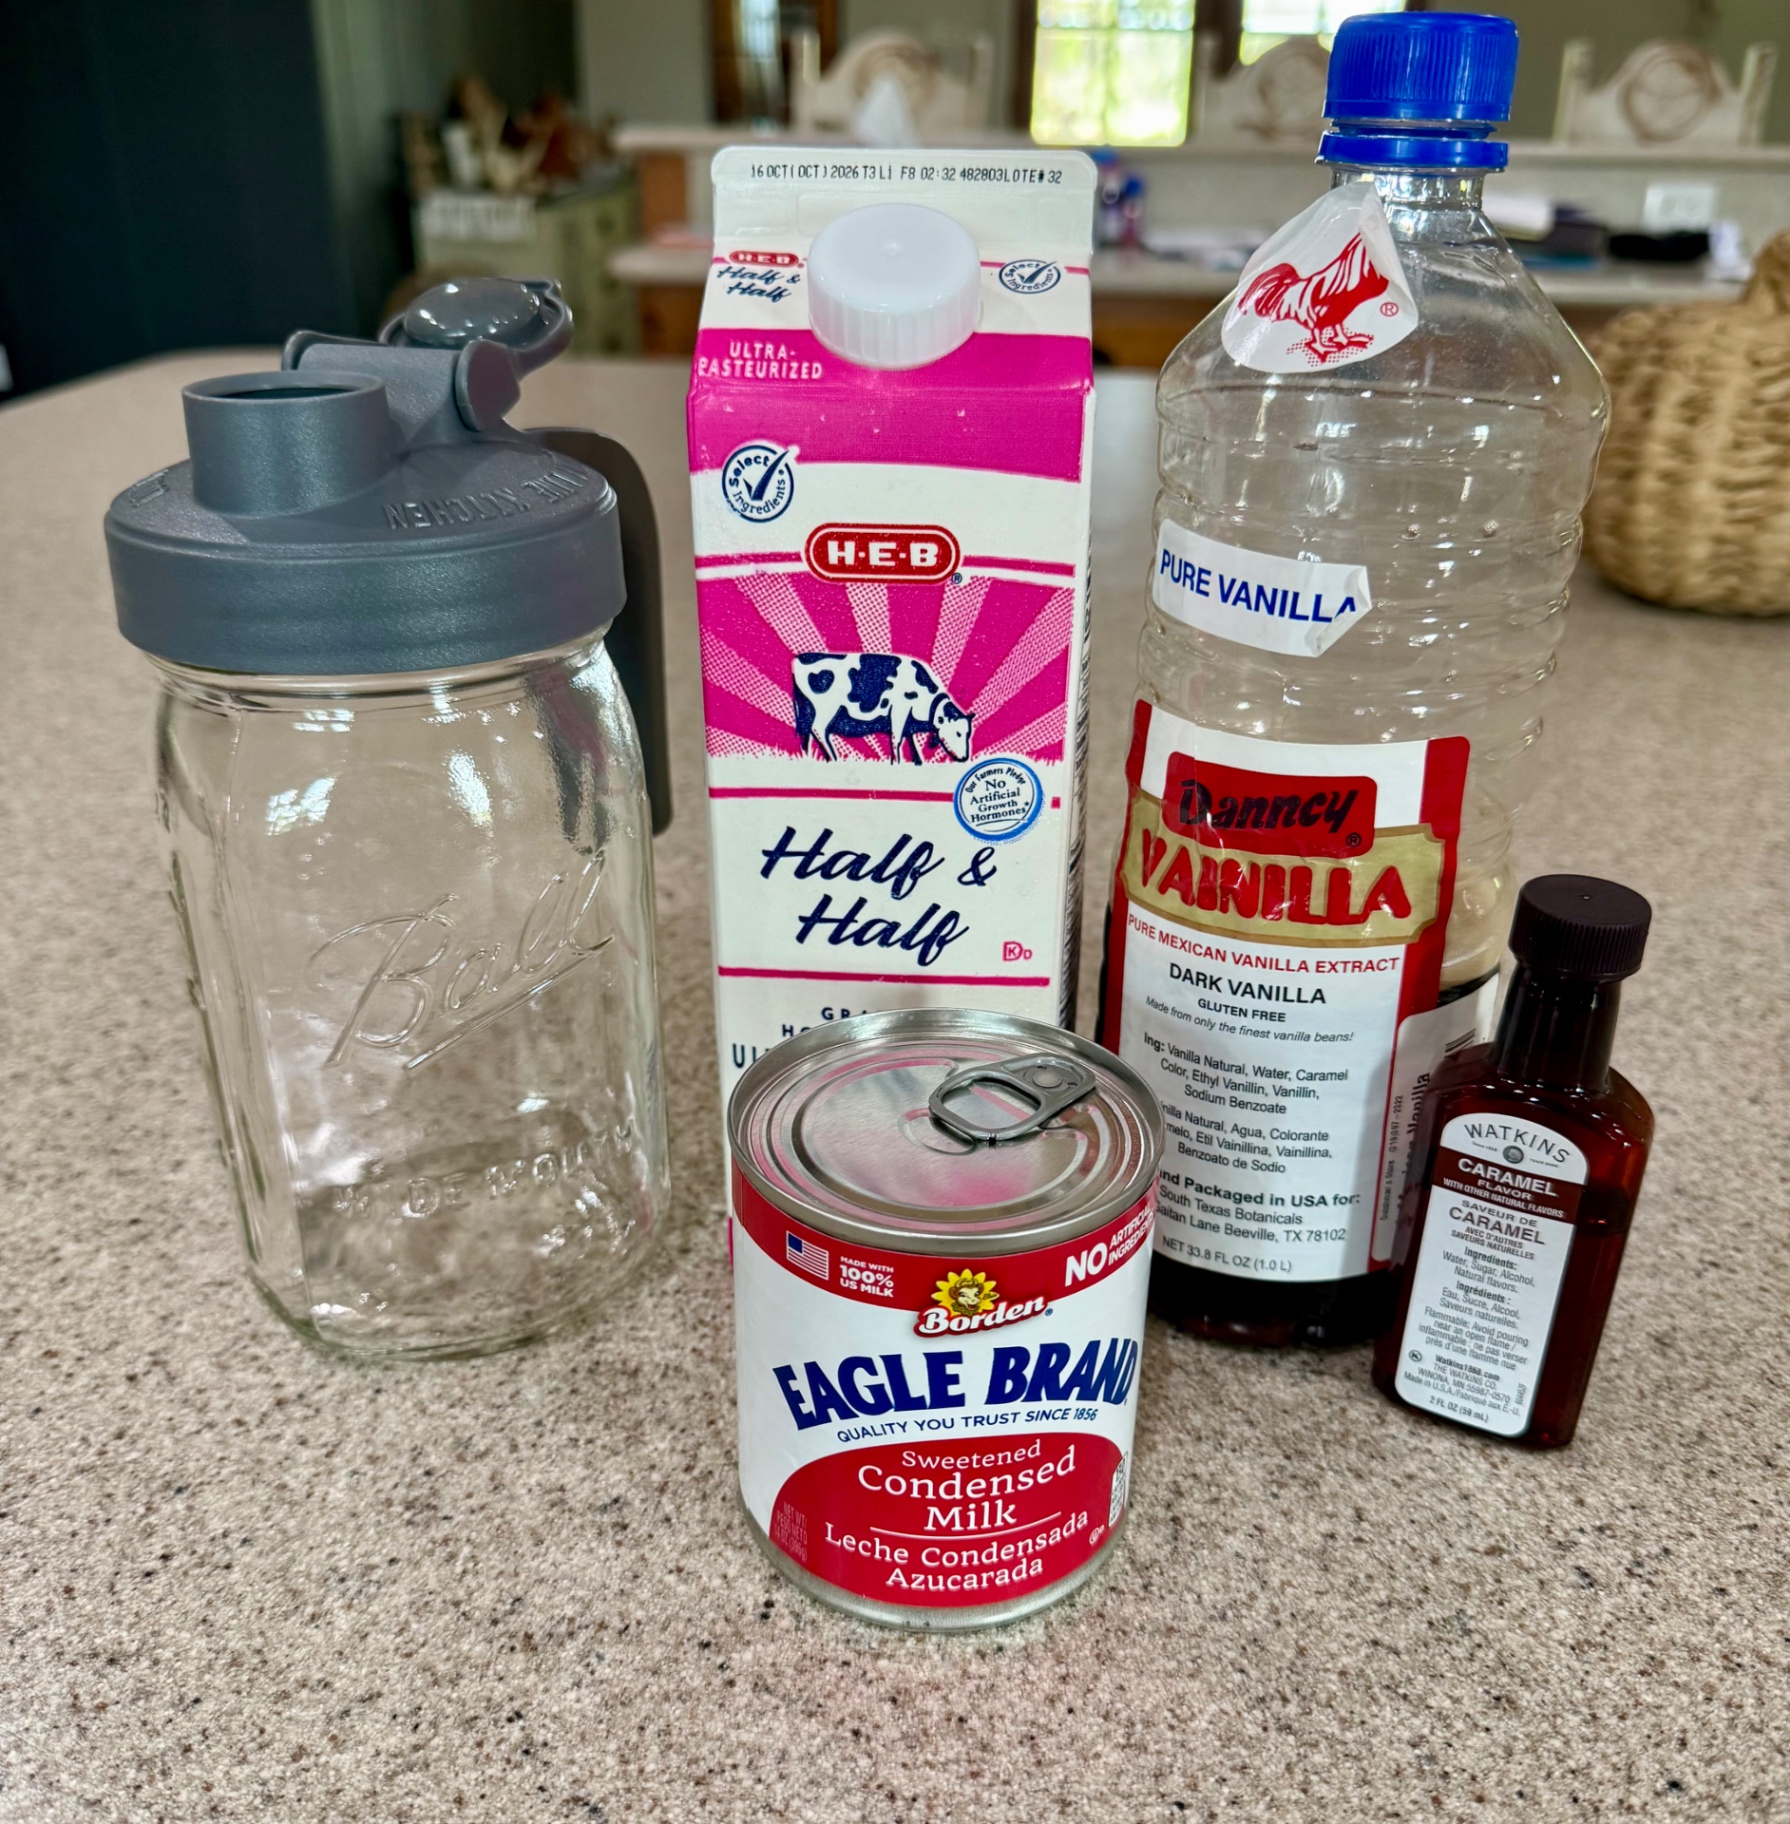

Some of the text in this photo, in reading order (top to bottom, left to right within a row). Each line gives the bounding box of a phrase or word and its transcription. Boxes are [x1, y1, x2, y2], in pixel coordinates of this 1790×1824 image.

[920, 166, 956, 181] 02:32
[717, 266, 801, 285] Half &
[1004, 262, 1041, 278] Select
[726, 281, 792, 303] Half
[729, 341, 797, 360] ULTRA-
[697, 357, 823, 380] PASTEURIZED
[729, 455, 770, 489] Select
[1160, 548, 1212, 598] PURE
[970, 787, 1021, 805] Artificial
[985, 778, 1007, 791] No
[978, 800, 1019, 813] Growth
[1178, 779, 1359, 834] Danncy
[760, 825, 998, 901] Half &
[1142, 828, 1412, 926] VAINILLA
[795, 893, 970, 967] Half
[1128, 914, 1400, 974] PURE MEXICAN VANILLA EXTRACT
[1169, 963, 1326, 1005] DARK VANILLA
[1145, 996, 1354, 1043] Made from only the finest vanilla beans!
[1198, 998, 1287, 1023] GLUTEN FREE
[1144, 1032, 1349, 1082] Ing: Vanilla Natural, Water, Caramel
[1160, 1058, 1320, 1100] Color, Ethyl Vanillin, Vanillin,
[1184, 1084, 1287, 1114] Sodium Benzoate
[1185, 1110, 1329, 1142] Natural, Agua, Colorante
[1178, 1141, 1286, 1173] Benzoato de Sodio
[1196, 1130, 1332, 1158] Etil Vainillina, Vainillina,
[1464, 1122, 1571, 1164] WATKINS
[1184, 1176, 1265, 1205] Packaged
[1269, 1193, 1285, 1207] in
[1291, 1195, 1328, 1207] USA
[1333, 1193, 1361, 1207] for:
[1458, 1158, 1560, 1198] CARAMEL
[1478, 1179, 1533, 1200] FLAVOR
[1159, 1184, 1303, 1225] South Texas Botanicals
[1443, 1178, 1564, 1218] WITH OTHER NATURAL FLAVORS
[1190, 1214, 1220, 1233] Lane
[1224, 1220, 1279, 1243] Beeville,
[1283, 1229, 1302, 1242] TX
[1306, 1228, 1346, 1242] 78102
[1449, 1207, 1545, 1245] CARAMEL
[1461, 1200, 1538, 1228] SAVEUR DE
[1451, 1230, 1535, 1260] SAVEURS NATURELLES
[1465, 1226, 1524, 1249] AVEC D'AUTRES
[840, 1256, 894, 1273] MADE WITH
[1065, 1242, 1108, 1287] NO
[1162, 1235, 1293, 1273] NET 33.8 FL OZ (1.0 L)
[1464, 1246, 1518, 1270] Ingredients:
[840, 1264, 894, 1287] 100%
[840, 1277, 894, 1298] US MILK
[1454, 1266, 1518, 1293] Natural flavors.
[918, 1296, 1045, 1334] Borden
[1439, 1297, 1473, 1316] Saveurs
[1434, 1320, 1510, 1350] near an open flame
[1472, 1320, 1495, 1336] Avoid
[1496, 1327, 1529, 1347] pouring
[1433, 1362, 1497, 1391] THE WATKINS CO.
[1500, 1360, 1517, 1371] nue
[772, 1338, 1139, 1431] EAGLE BRAND
[1452, 1378, 1465, 1389] MN
[1447, 1401, 1458, 1412] OZ
[836, 1407, 1099, 1443] QUALITY YOU TRUST SINCE 1856
[902, 1439, 1041, 1470] Sweetened
[858, 1445, 1076, 1500] Condensed
[924, 1498, 1017, 1531] Milk
[824, 1522, 909, 1563] Leche
[921, 1510, 1089, 1568] Condensada
[885, 1557, 1043, 1592] Azucarada
